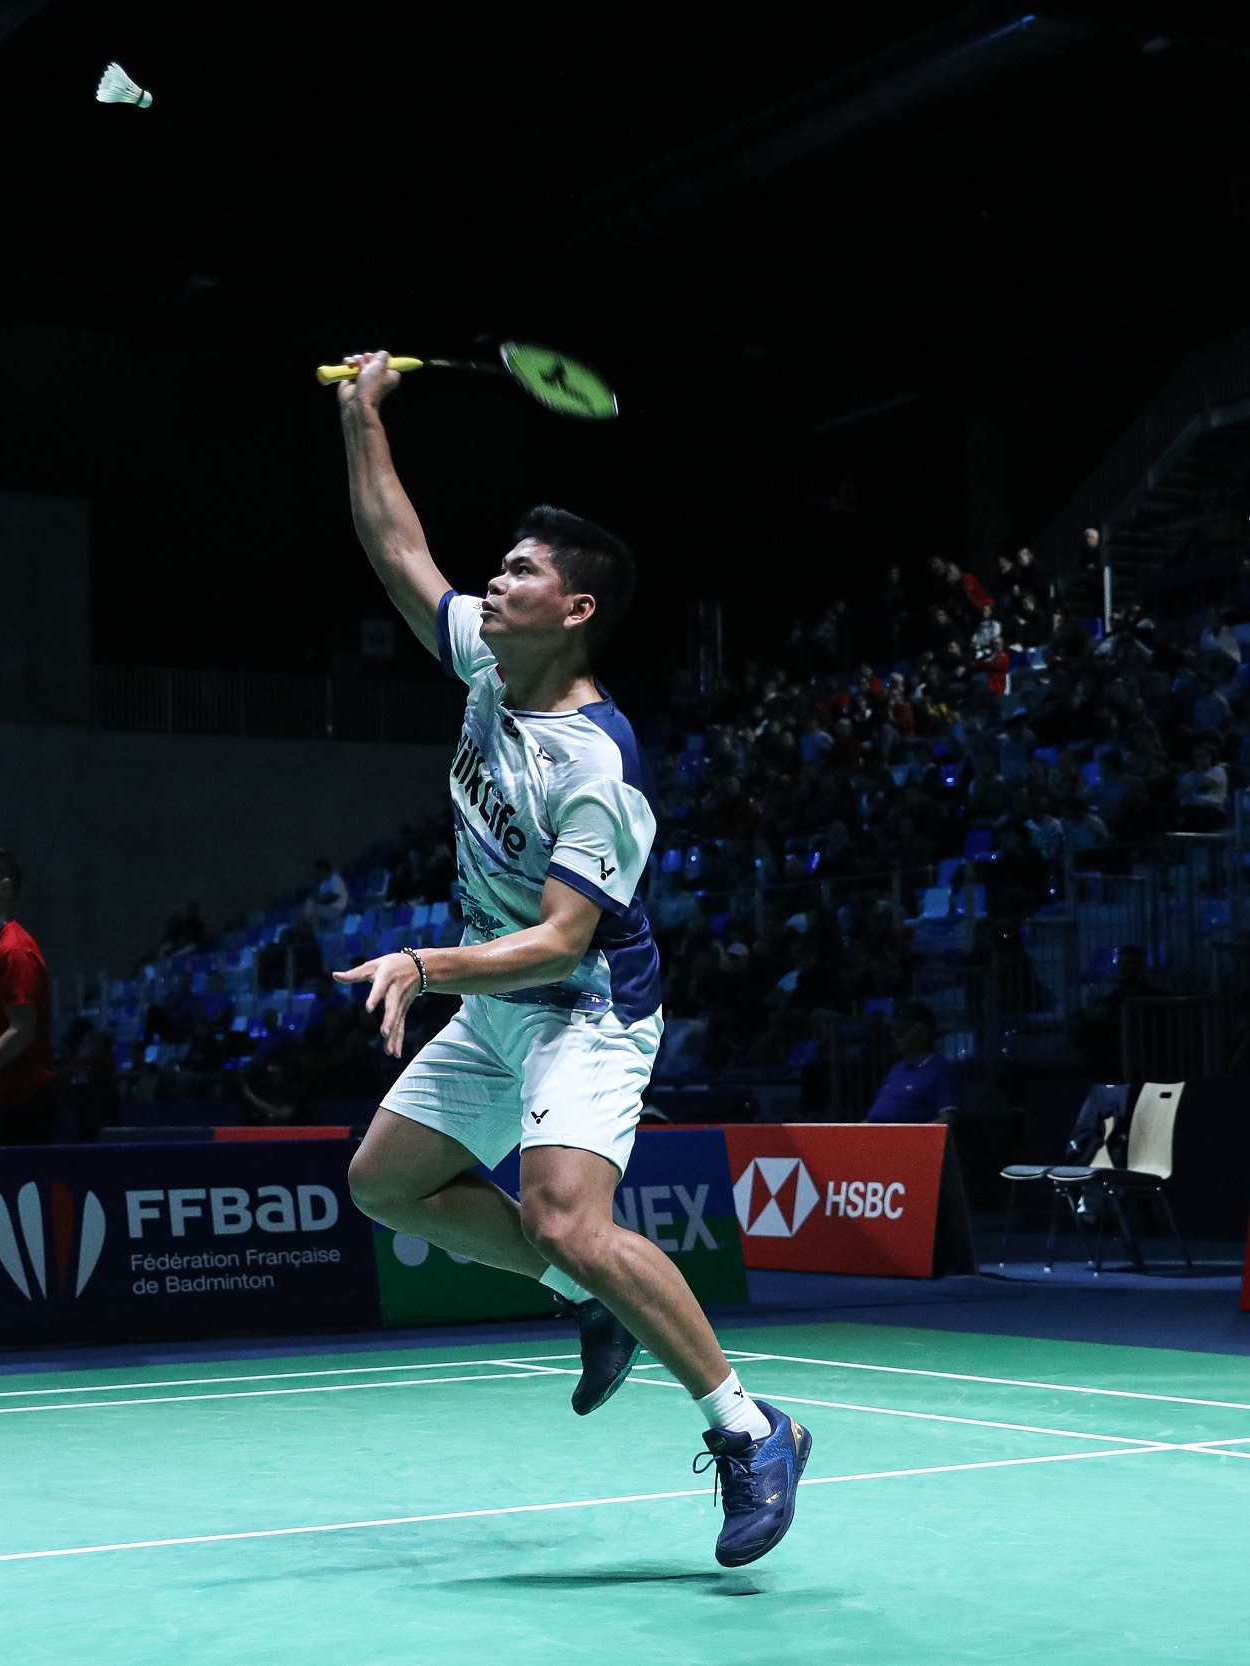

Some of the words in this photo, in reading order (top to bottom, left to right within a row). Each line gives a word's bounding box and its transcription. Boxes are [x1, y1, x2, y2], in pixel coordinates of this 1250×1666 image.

[451, 733, 527, 861] ilkLife
[613, 1183, 719, 1252] NEX
[825, 1181, 907, 1220] HSBC
[130, 1251, 240, 1272] Fédération
[246, 1246, 342, 1268] Française
[132, 1277, 159, 1295] de
[166, 1273, 276, 1293] Badminton
